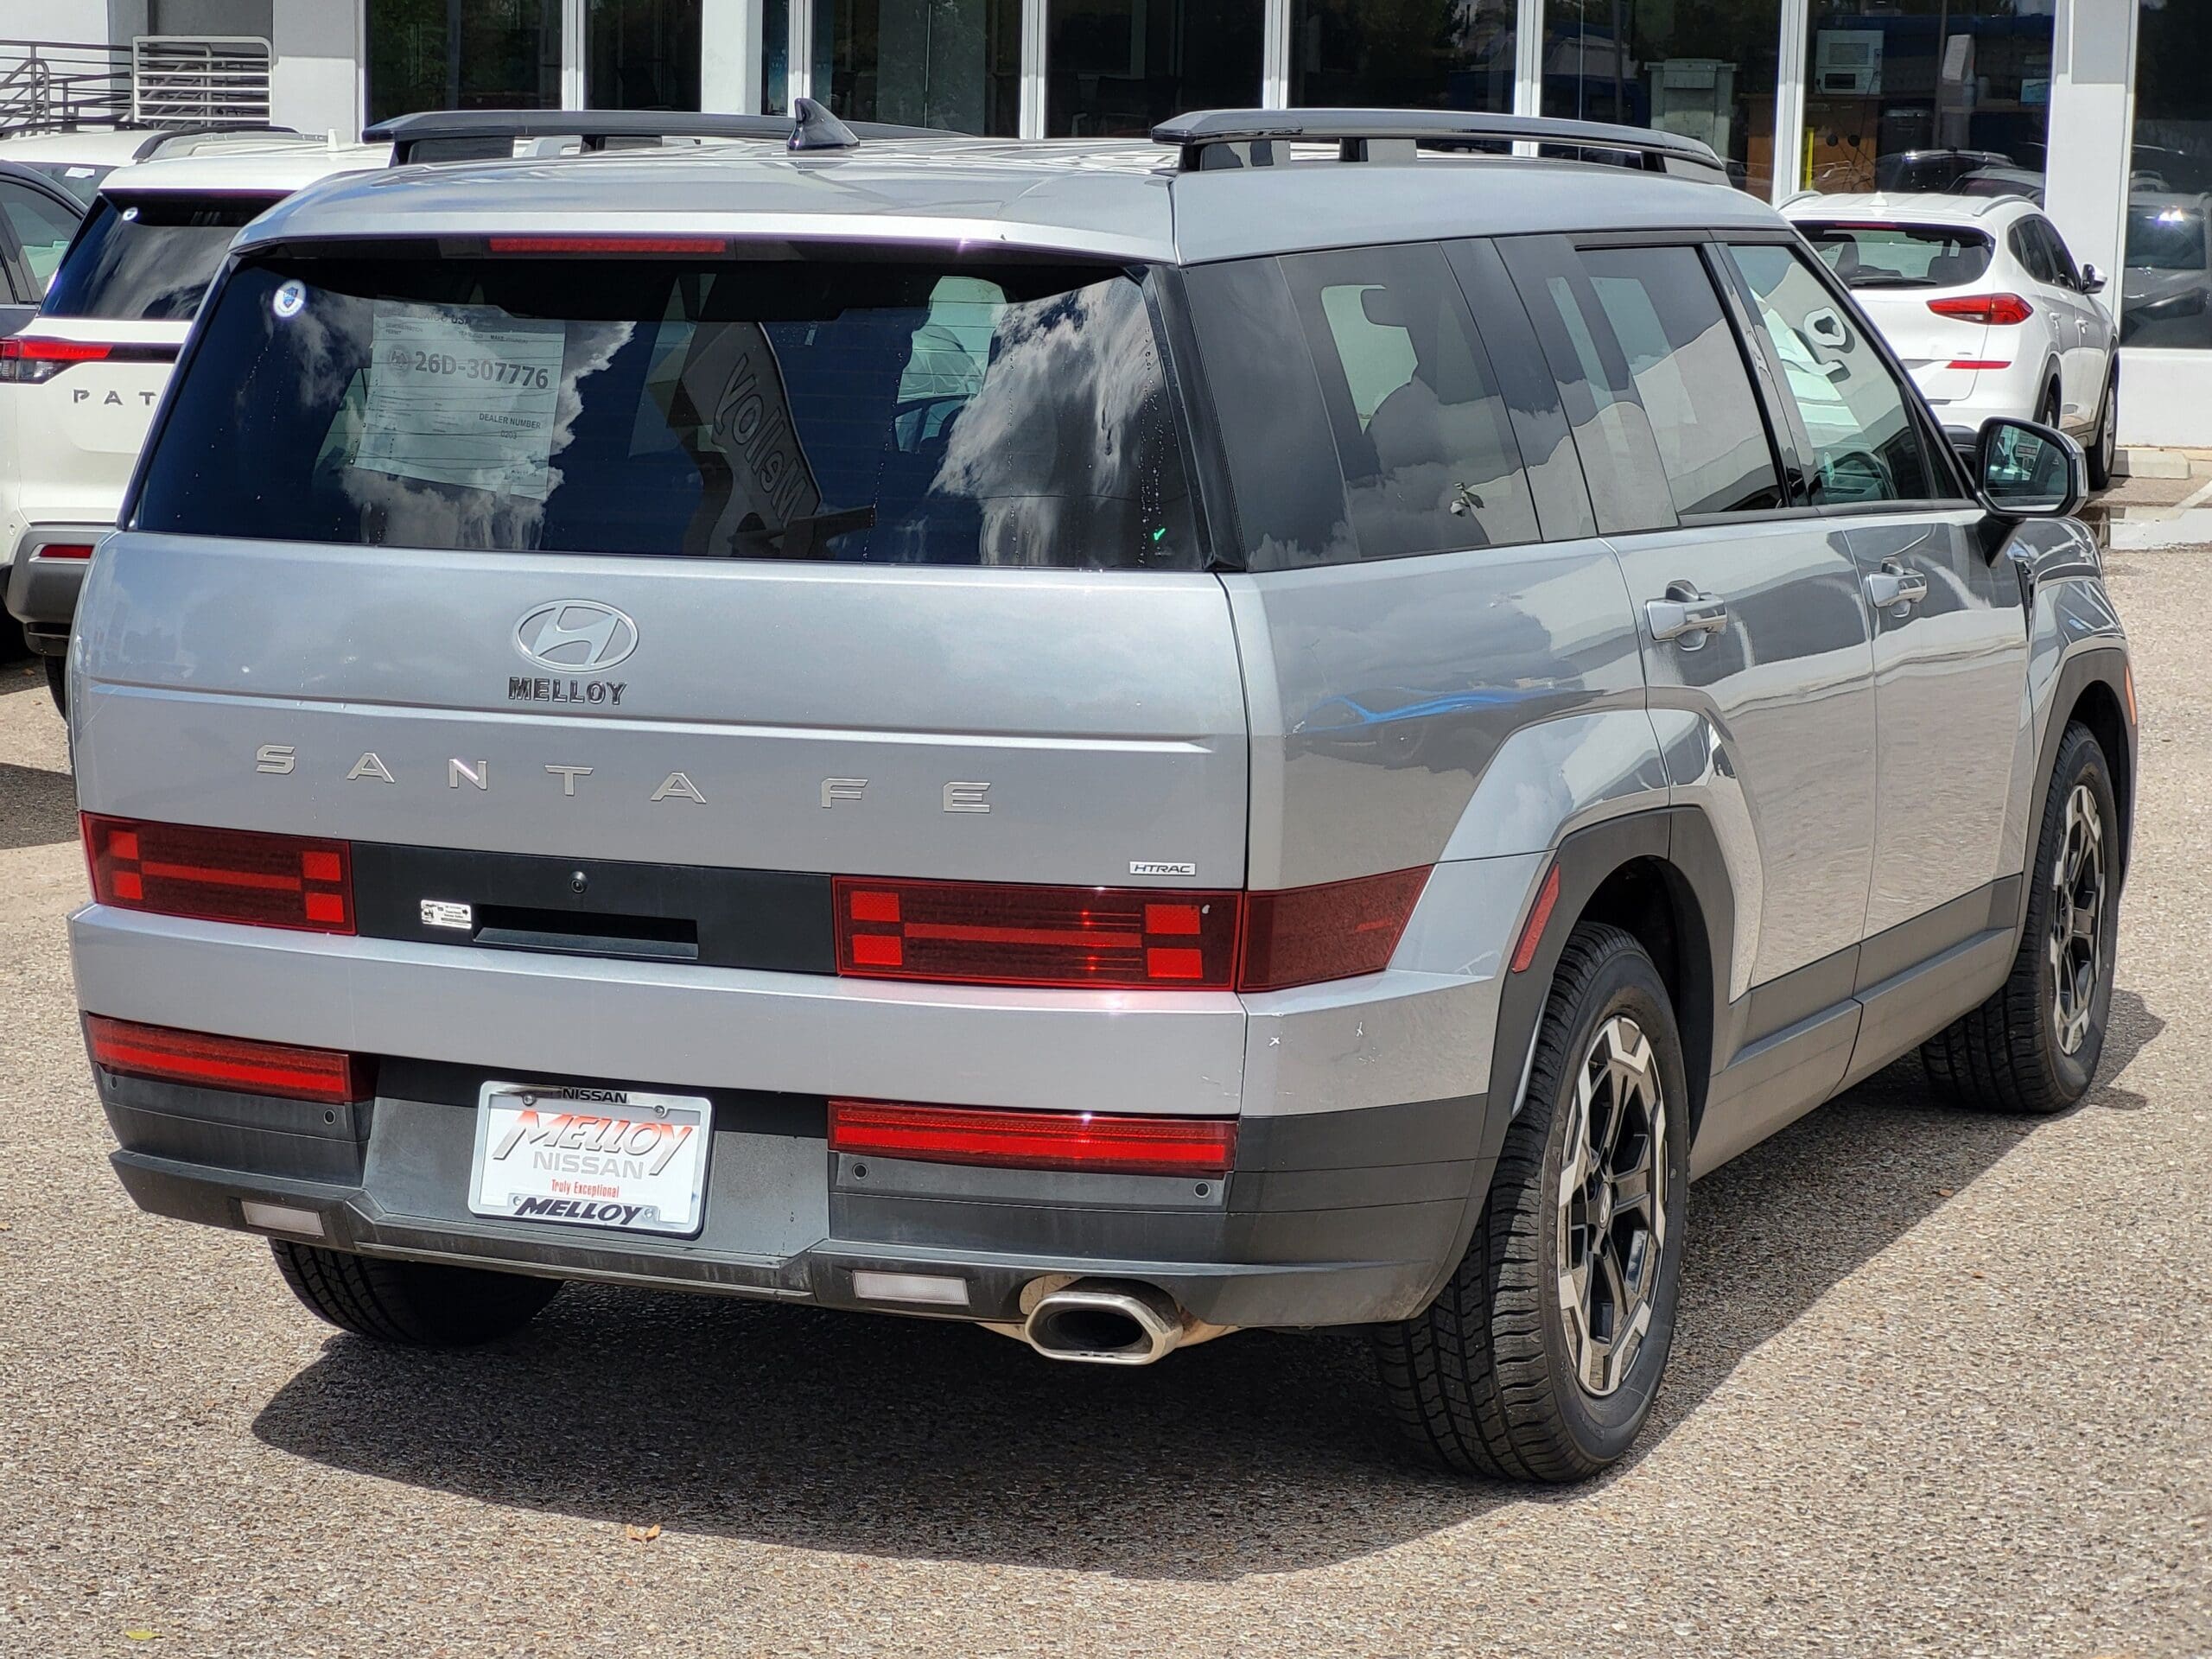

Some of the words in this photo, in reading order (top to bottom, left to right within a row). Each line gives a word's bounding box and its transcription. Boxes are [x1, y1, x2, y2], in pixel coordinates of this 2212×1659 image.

[415, 351, 549, 389] 26D-307776
[73, 389, 156, 406] PAT
[479, 413, 508, 424] DEALER
[511, 416, 541, 429] NUMBER
[508, 677, 627, 705] MELLOY
[256, 744, 707, 804] SANTA
[821, 778, 992, 813] FE
[1134, 864, 1191, 874] HTRAC
[563, 1087, 628, 1104] NISSAN
[493, 1109, 693, 1176] MELLOY
[532, 1151, 644, 1179] NISSAN
[551, 1179, 571, 1195] Truly
[574, 1181, 620, 1198] Exceptional
[513, 1196, 644, 1225] MELLOY
